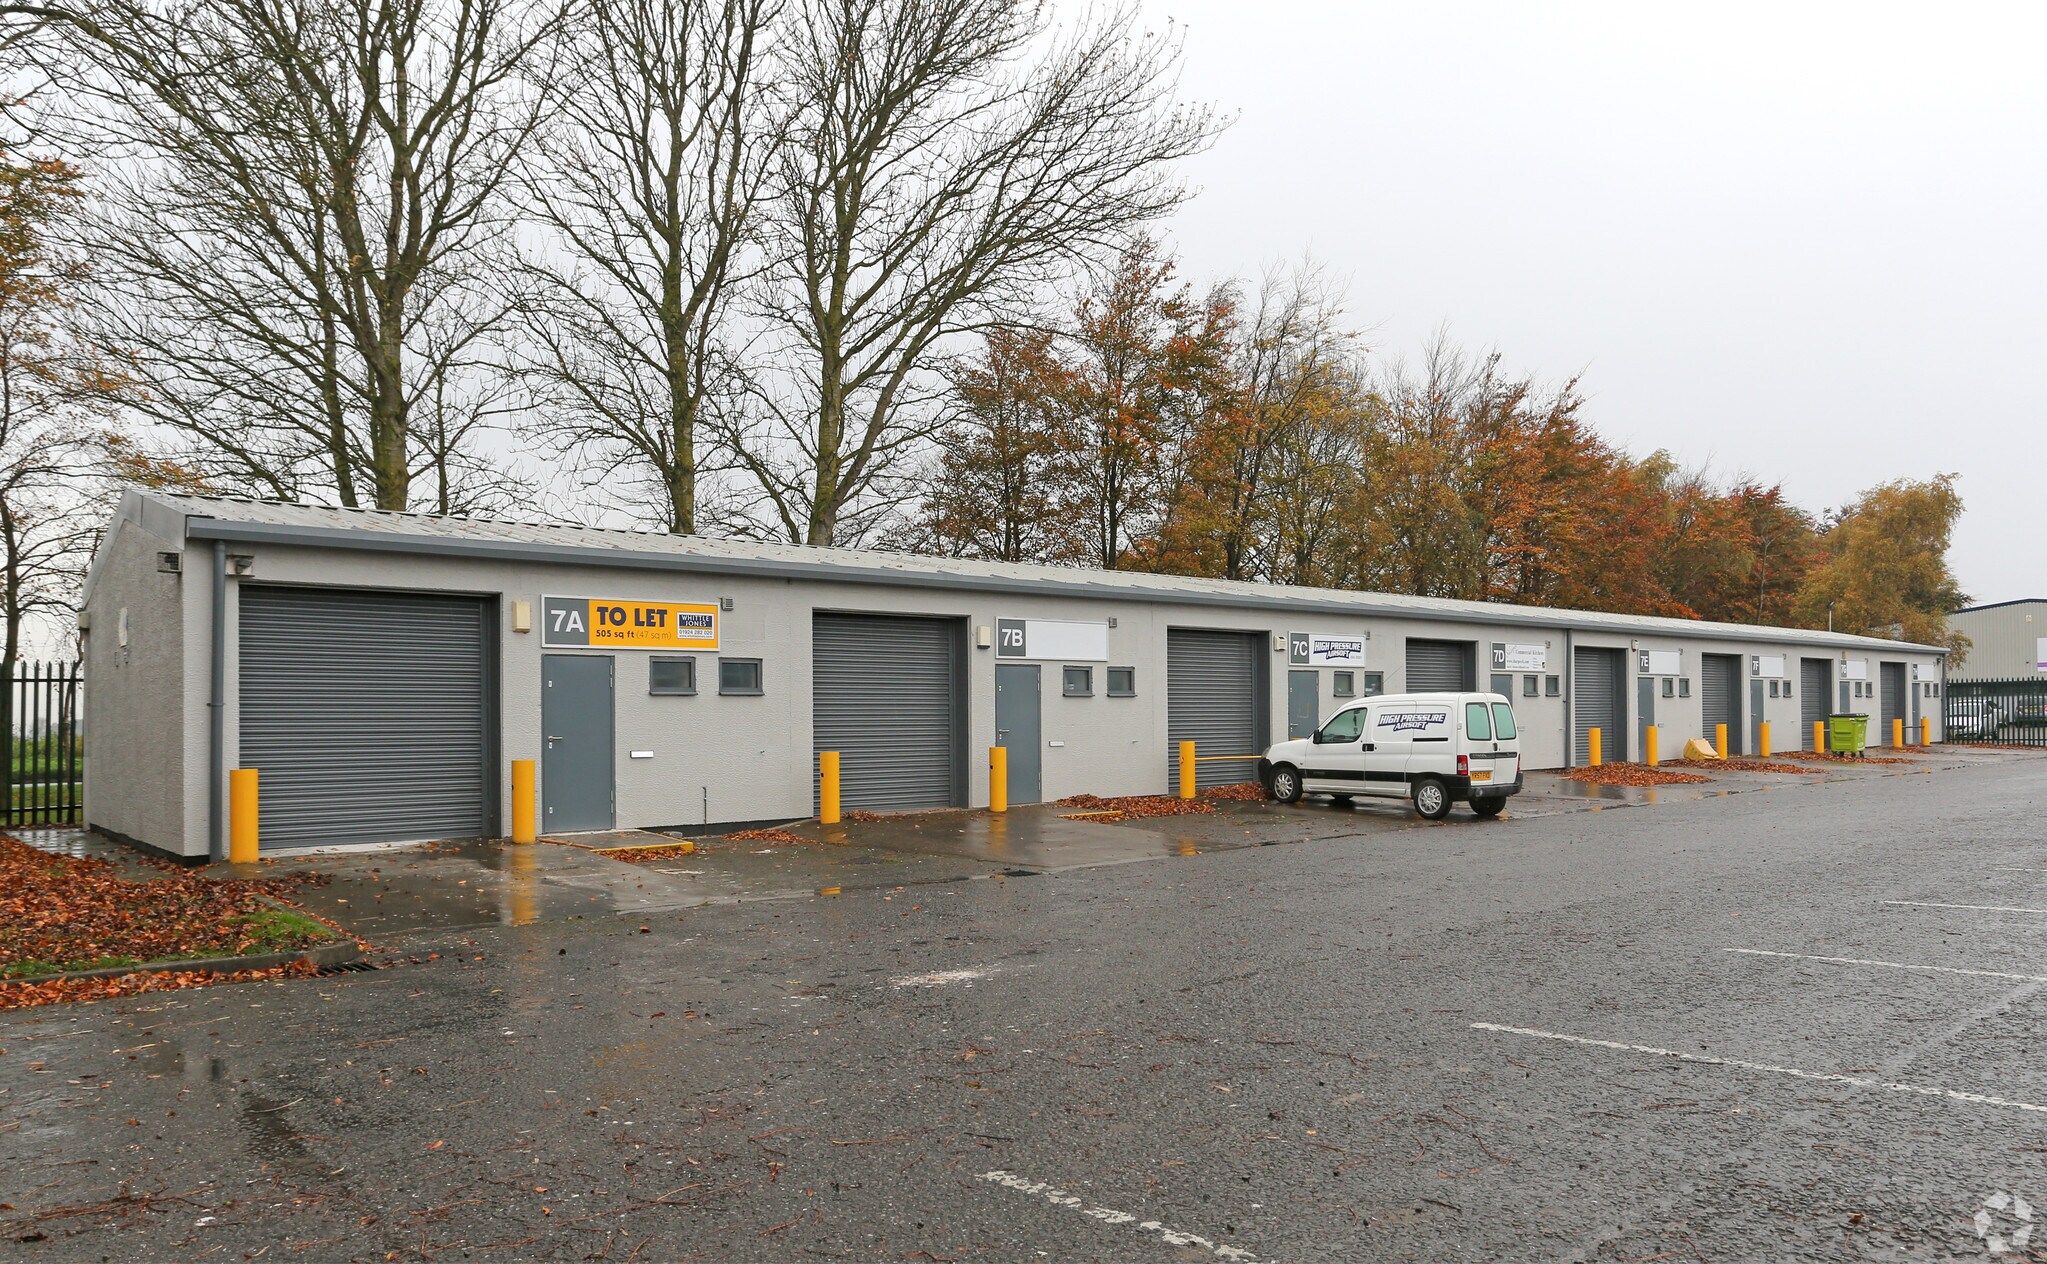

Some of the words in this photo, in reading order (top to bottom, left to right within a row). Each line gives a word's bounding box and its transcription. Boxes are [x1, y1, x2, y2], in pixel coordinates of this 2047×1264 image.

[551, 610, 585, 633] 7A
[597, 606, 627, 626] TO
[634, 608, 668, 628] LET
[614, 631, 624, 639] sq
[627, 630, 635, 638] ft
[636, 630, 649, 639] (47
[651, 633, 660, 641] sq
[661, 632, 672, 640] m)
[1001, 628, 1024, 647] 7B
[1292, 641, 1308, 656] 7C
[1314, 641, 1330, 652] HIGH
[1330, 641, 1362, 652] PRESSURE
[1326, 650, 1350, 659] AIRSOFT
[1494, 650, 1505, 662] 7D
[1640, 655, 1648, 667] 7E
[1752, 660, 1759, 670] 7F
[1379, 714, 1400, 725] HIGH
[1400, 713, 1446, 722] PRESSURE
[1394, 721, 1428, 731] AIRSOFT
